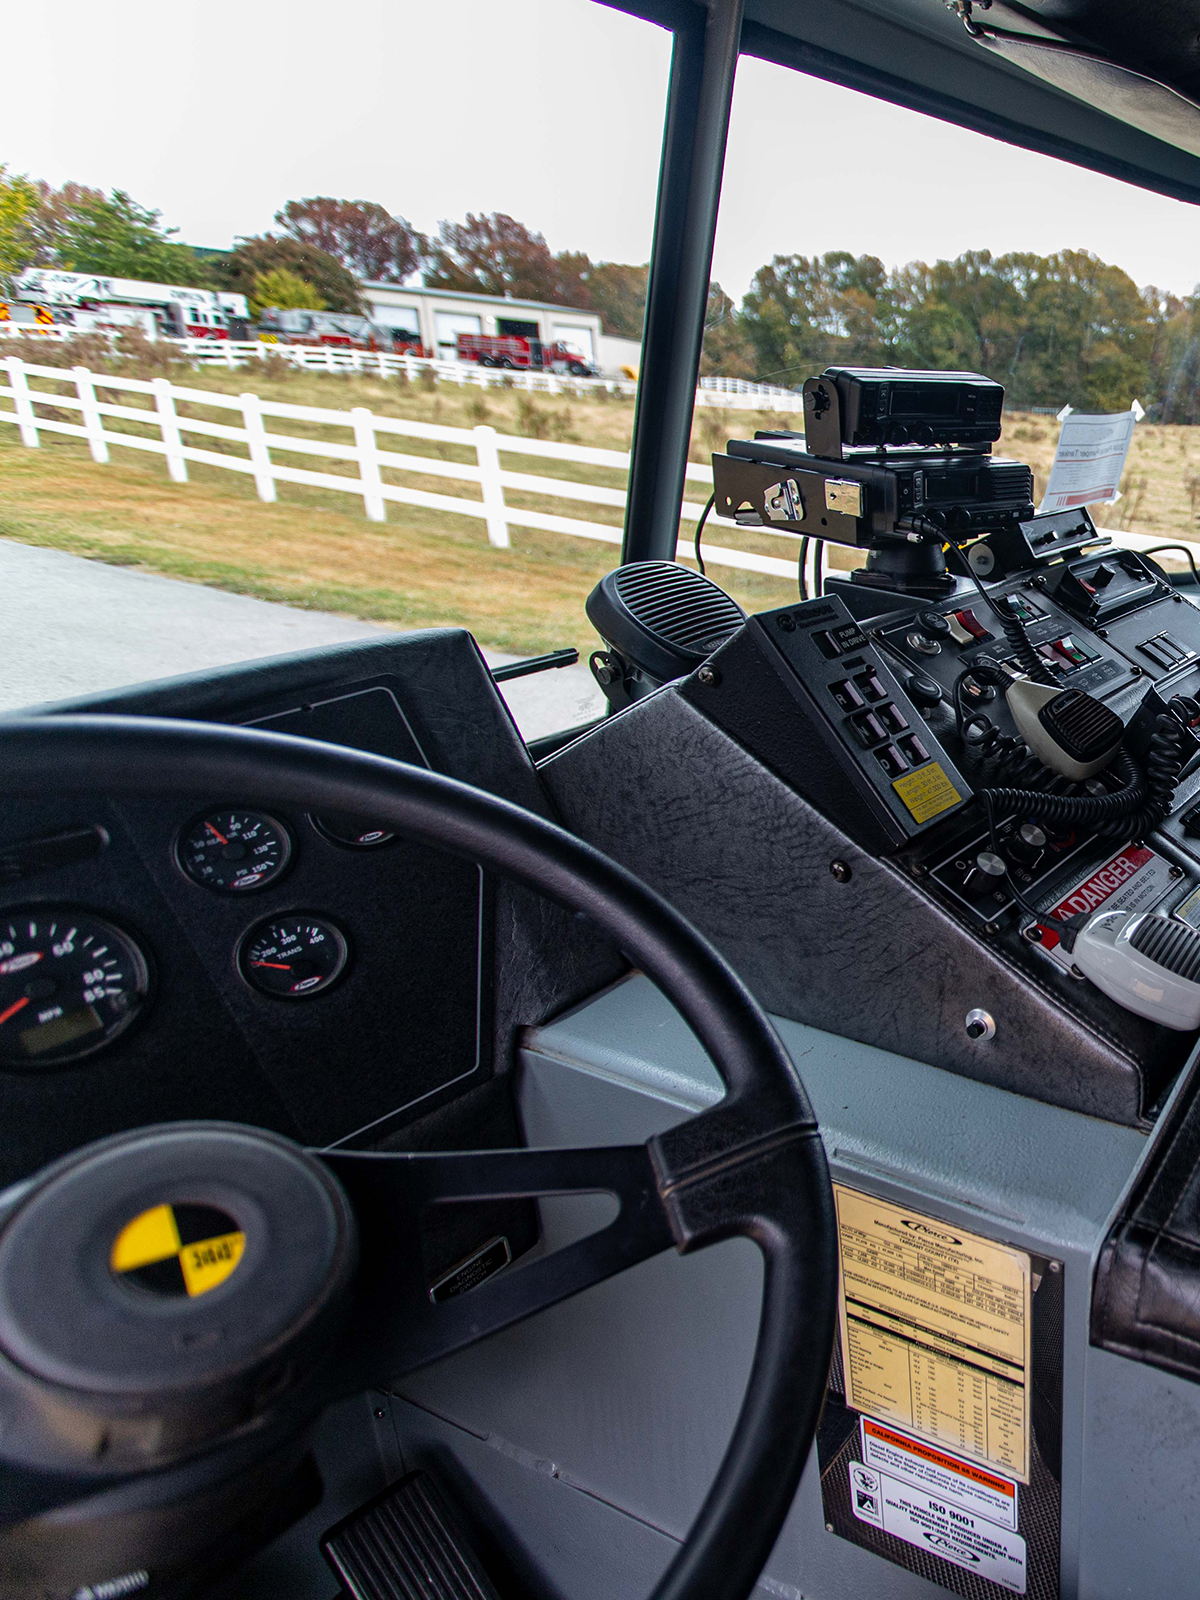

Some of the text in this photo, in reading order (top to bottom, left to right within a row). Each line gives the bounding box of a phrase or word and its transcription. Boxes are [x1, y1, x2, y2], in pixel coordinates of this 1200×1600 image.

[839, 627, 856, 640] PUMP
[841, 633, 868, 648] IN DRIVE
[835, 694, 847, 705] R
[860, 726, 870, 737] N
[880, 758, 890, 770] D
[898, 776, 917, 790] Height:
[903, 784, 922, 797] Length:
[908, 791, 927, 805] Weight:
[925, 782, 942, 795] 47,000
[230, 822, 242, 830] 90
[242, 830, 257, 840] 110
[206, 837, 220, 847] REA
[253, 845, 269, 855] 130
[236, 868, 248, 877] PSI
[252, 863, 268, 874] 150
[1068, 856, 1139, 915] DANGER
[1110, 868, 1156, 910] BE SEATED AND BELTED
[280, 934, 297, 945] 300
[309, 934, 325, 945] 400
[53, 941, 74, 957] 60
[261, 946, 277, 957] 200
[276, 945, 303, 960] TRANS
[83, 968, 104, 985] 80
[83, 985, 105, 1003] 85
[37, 1006, 63, 1023] MPH
[873, 1219, 907, 1236] Manufactured
[918, 1236, 933, 1245] Pierce
[934, 1242, 973, 1261] Manufacturing,
[913, 1222, 946, 1241] Pierce
[899, 1238, 922, 1250] TARRANT
[924, 1247, 946, 1259] COUNTY
[948, 1256, 959, 1264] (TX)
[449, 1258, 493, 1293] DIAGNOSTIC
[456, 1259, 482, 1281] ENGINE
[460, 1270, 487, 1293] SWITCH
[843, 1273, 866, 1285] STANDARDS
[871, 1284, 886, 1292] EFFECT
[919, 1303, 949, 1317] MANUFACTURE
[950, 1314, 965, 1324] SHOWN
[966, 1321, 981, 1330] ABOVE.
[852, 1272, 868, 1282] VEHICLE
[869, 1279, 891, 1290] CONFORMS
[906, 1293, 930, 1306] APPLICABLE
[939, 1306, 958, 1316] FEDERAL
[959, 1314, 974, 1322] MOTOR
[975, 1320, 991, 1329] VEHICLE
[993, 1327, 1009, 1336] SAFETY
[976, 1342, 998, 1355] Emergency
[999, 1351, 1013, 1360] Vehicle
[871, 1427, 911, 1449] CALIFORNIA
[913, 1445, 959, 1470] PROPOSITION
[971, 1471, 1005, 1490] WARNING
[869, 1441, 885, 1451] Diesel
[885, 1448, 903, 1459] Engine
[904, 1456, 924, 1468] exhaust
[925, 1465, 935, 1473] and
[936, 1471, 950, 1480] some
[967, 1483, 999, 1502] constituents
[869, 1446, 886, 1457] known
[894, 1456, 902, 1464] the
[903, 1461, 916, 1470] State
[924, 1470, 949, 1485] California
[957, 1486, 972, 1495] cause
[974, 1493, 993, 1505] cancer,
[995, 1502, 1008, 1511] birth
[870, 1452, 963, 1497] defects and other reproductive harm.
[928, 1500, 974, 1528] ISO 9001
[885, 1498, 1022, 1565] QUALITY MANAGEMENT SYSTEM COMPLIANT WITH
[899, 1498, 911, 1508] THIS
[912, 1504, 934, 1518] VEHICLE
[935, 1515, 948, 1525] WAS
[950, 1521, 980, 1540] PRODUCED
[982, 1536, 1002, 1549] UNDER
[909, 1516, 996, 1560] ISO 9001:2000 REQUIREMENTS.
[935, 1536, 966, 1557] Pierce
